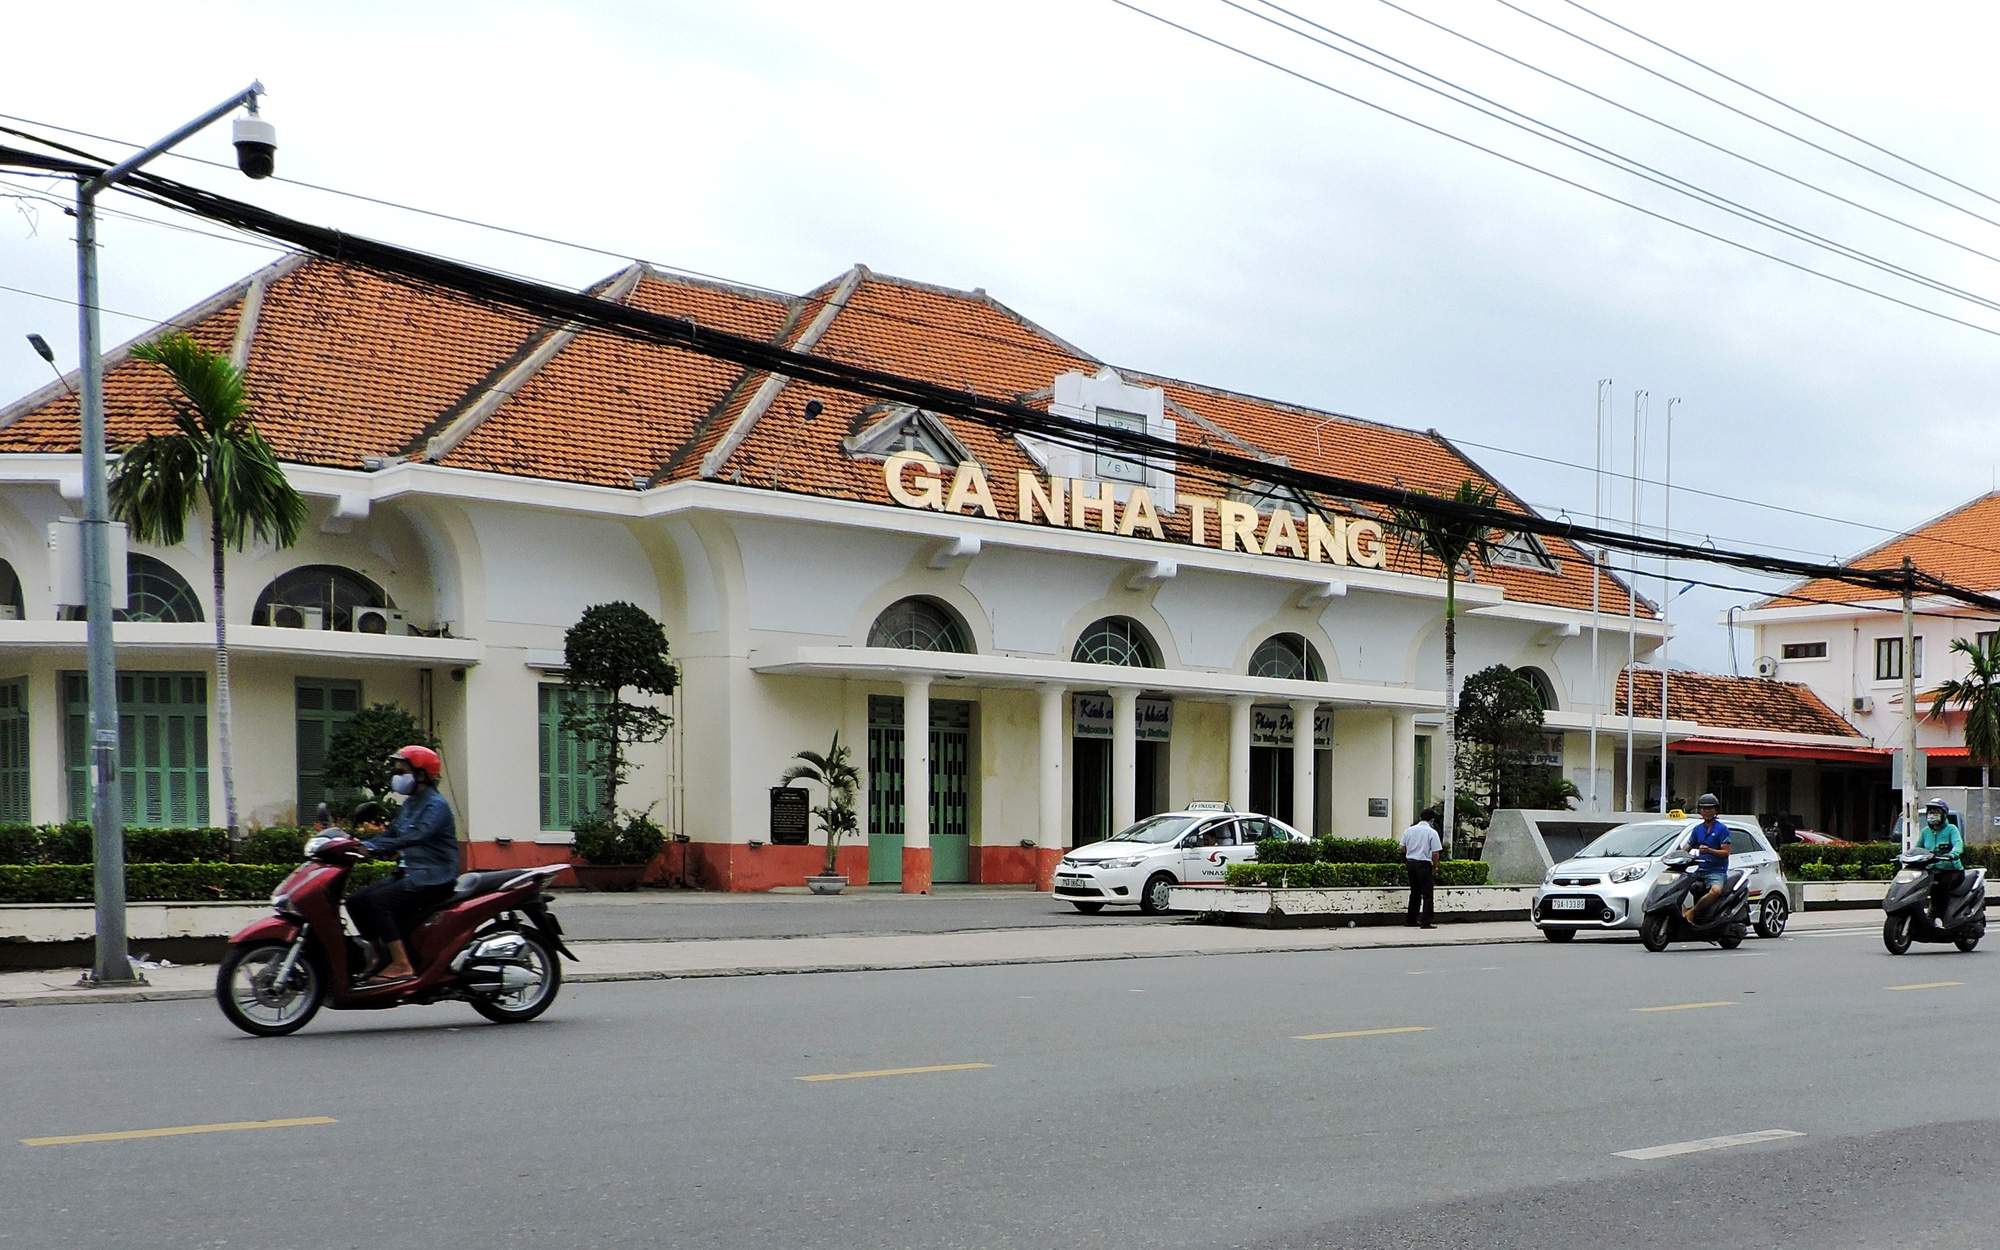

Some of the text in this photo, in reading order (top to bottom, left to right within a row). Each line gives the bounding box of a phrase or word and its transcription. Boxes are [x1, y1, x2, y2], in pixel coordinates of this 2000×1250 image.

[1114, 464, 1122, 473] 6
[883, 450, 1387, 569] GA NHA TRANG
[1536, 754, 1559, 763] OFFICE
